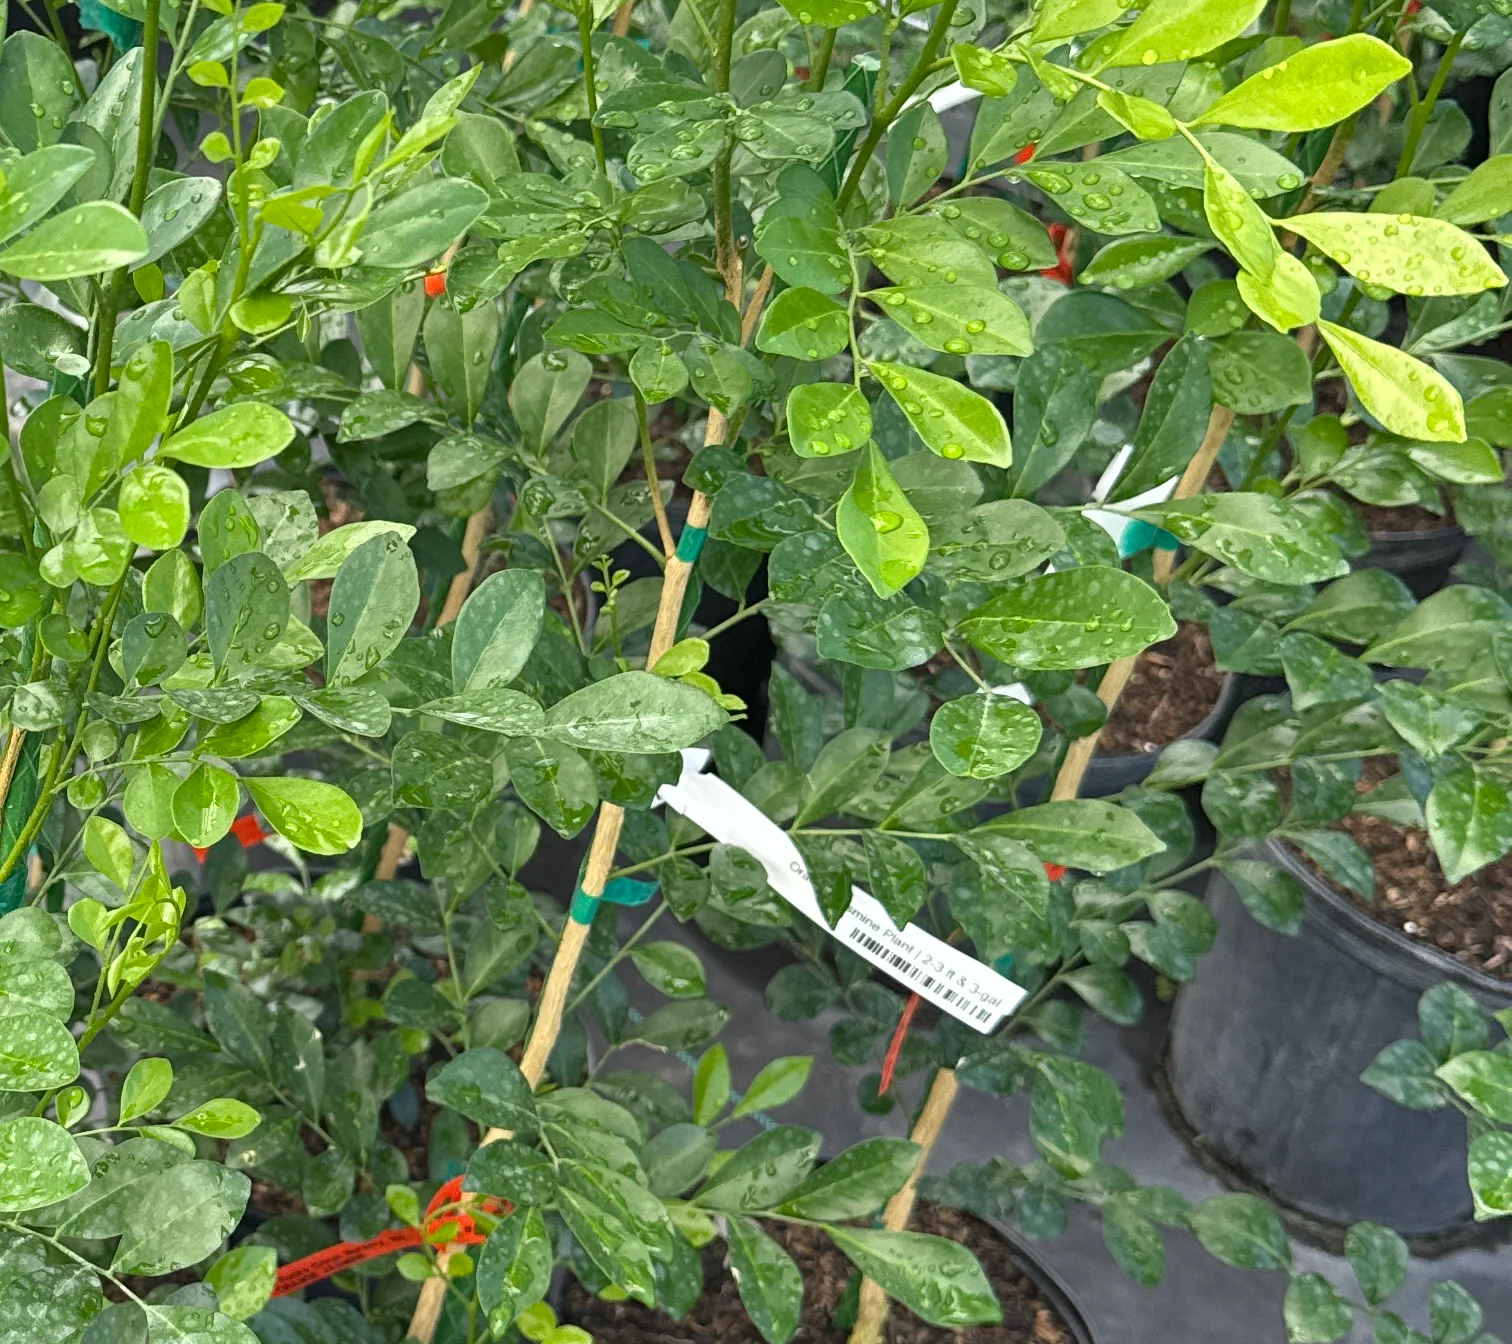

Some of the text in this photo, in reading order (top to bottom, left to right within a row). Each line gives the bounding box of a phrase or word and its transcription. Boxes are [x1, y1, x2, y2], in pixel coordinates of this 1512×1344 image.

[882, 928, 916, 954] Plant
[922, 953, 946, 974] 2-3
[954, 974, 968, 988] &
[967, 982, 1003, 1009] 3-gal
